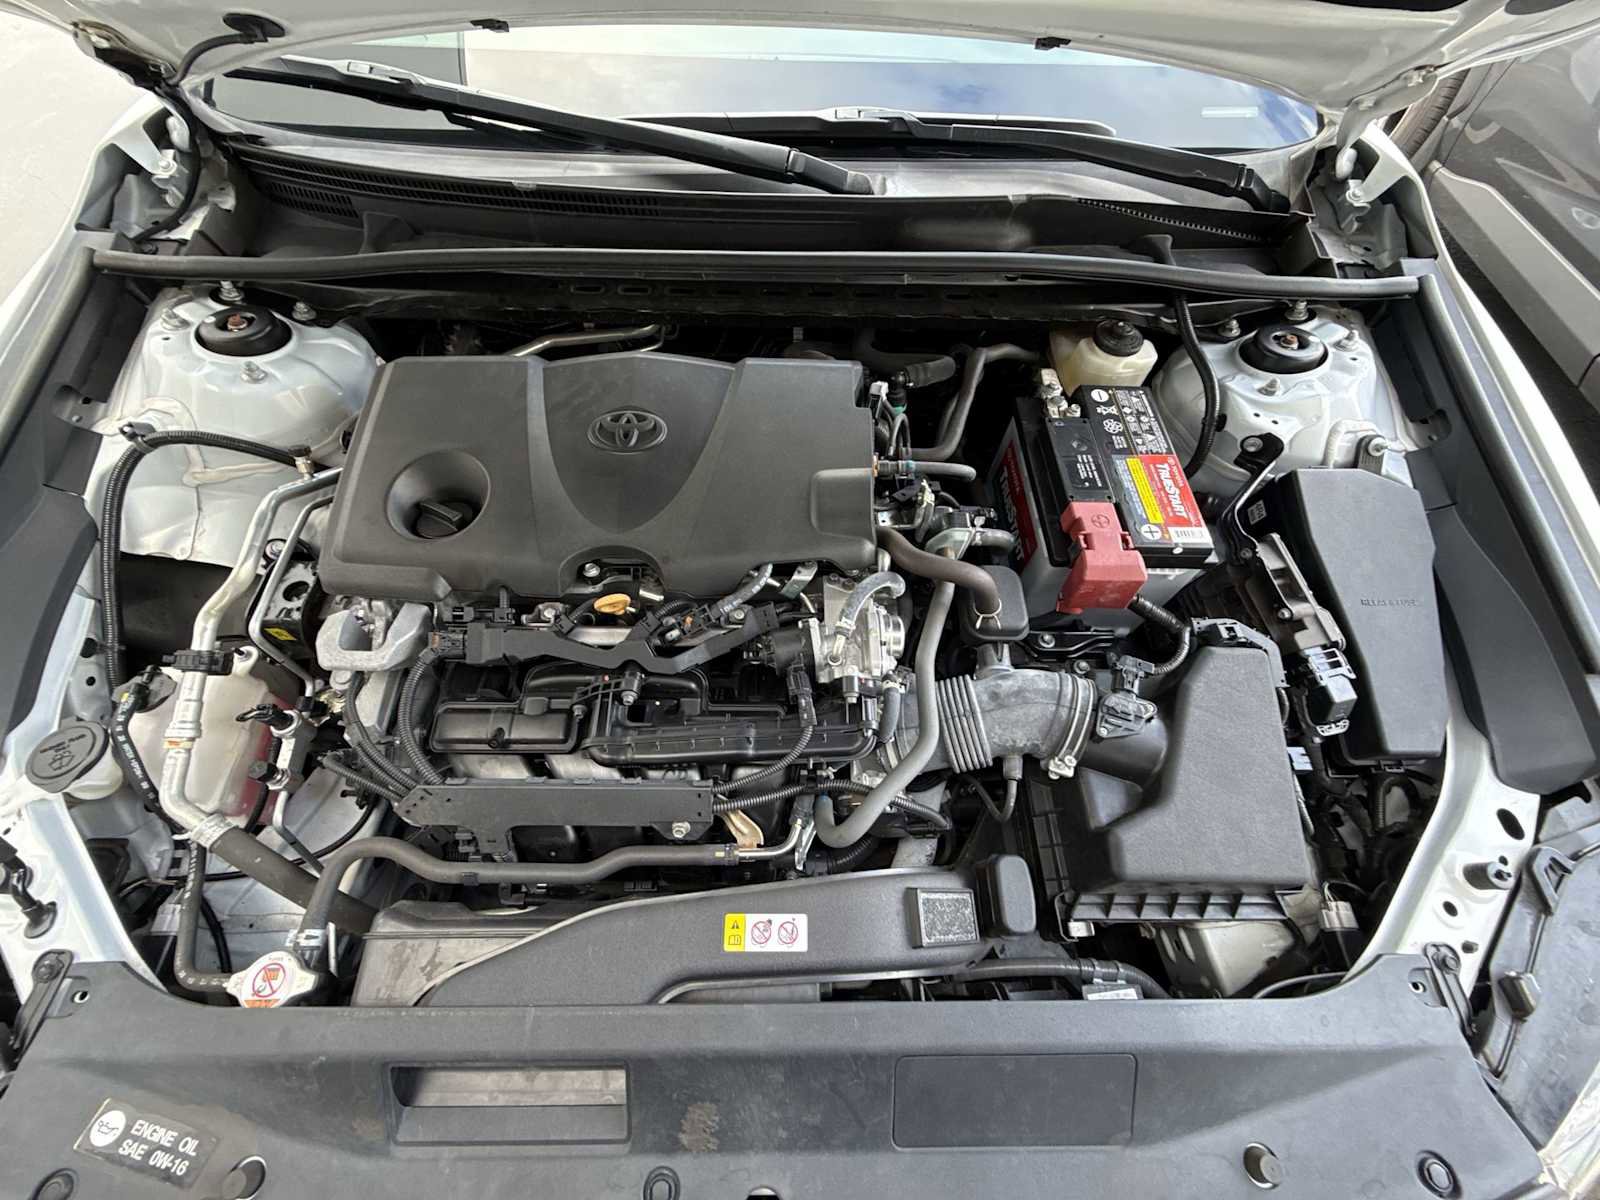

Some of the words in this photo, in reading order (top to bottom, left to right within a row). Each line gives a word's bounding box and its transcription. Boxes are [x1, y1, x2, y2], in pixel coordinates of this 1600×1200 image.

[130, 1119, 178, 1147] ENGINE
[178, 1136, 199, 1156] OIL
[118, 1138, 149, 1161] SAE
[148, 1150, 189, 1176] 0W-16
